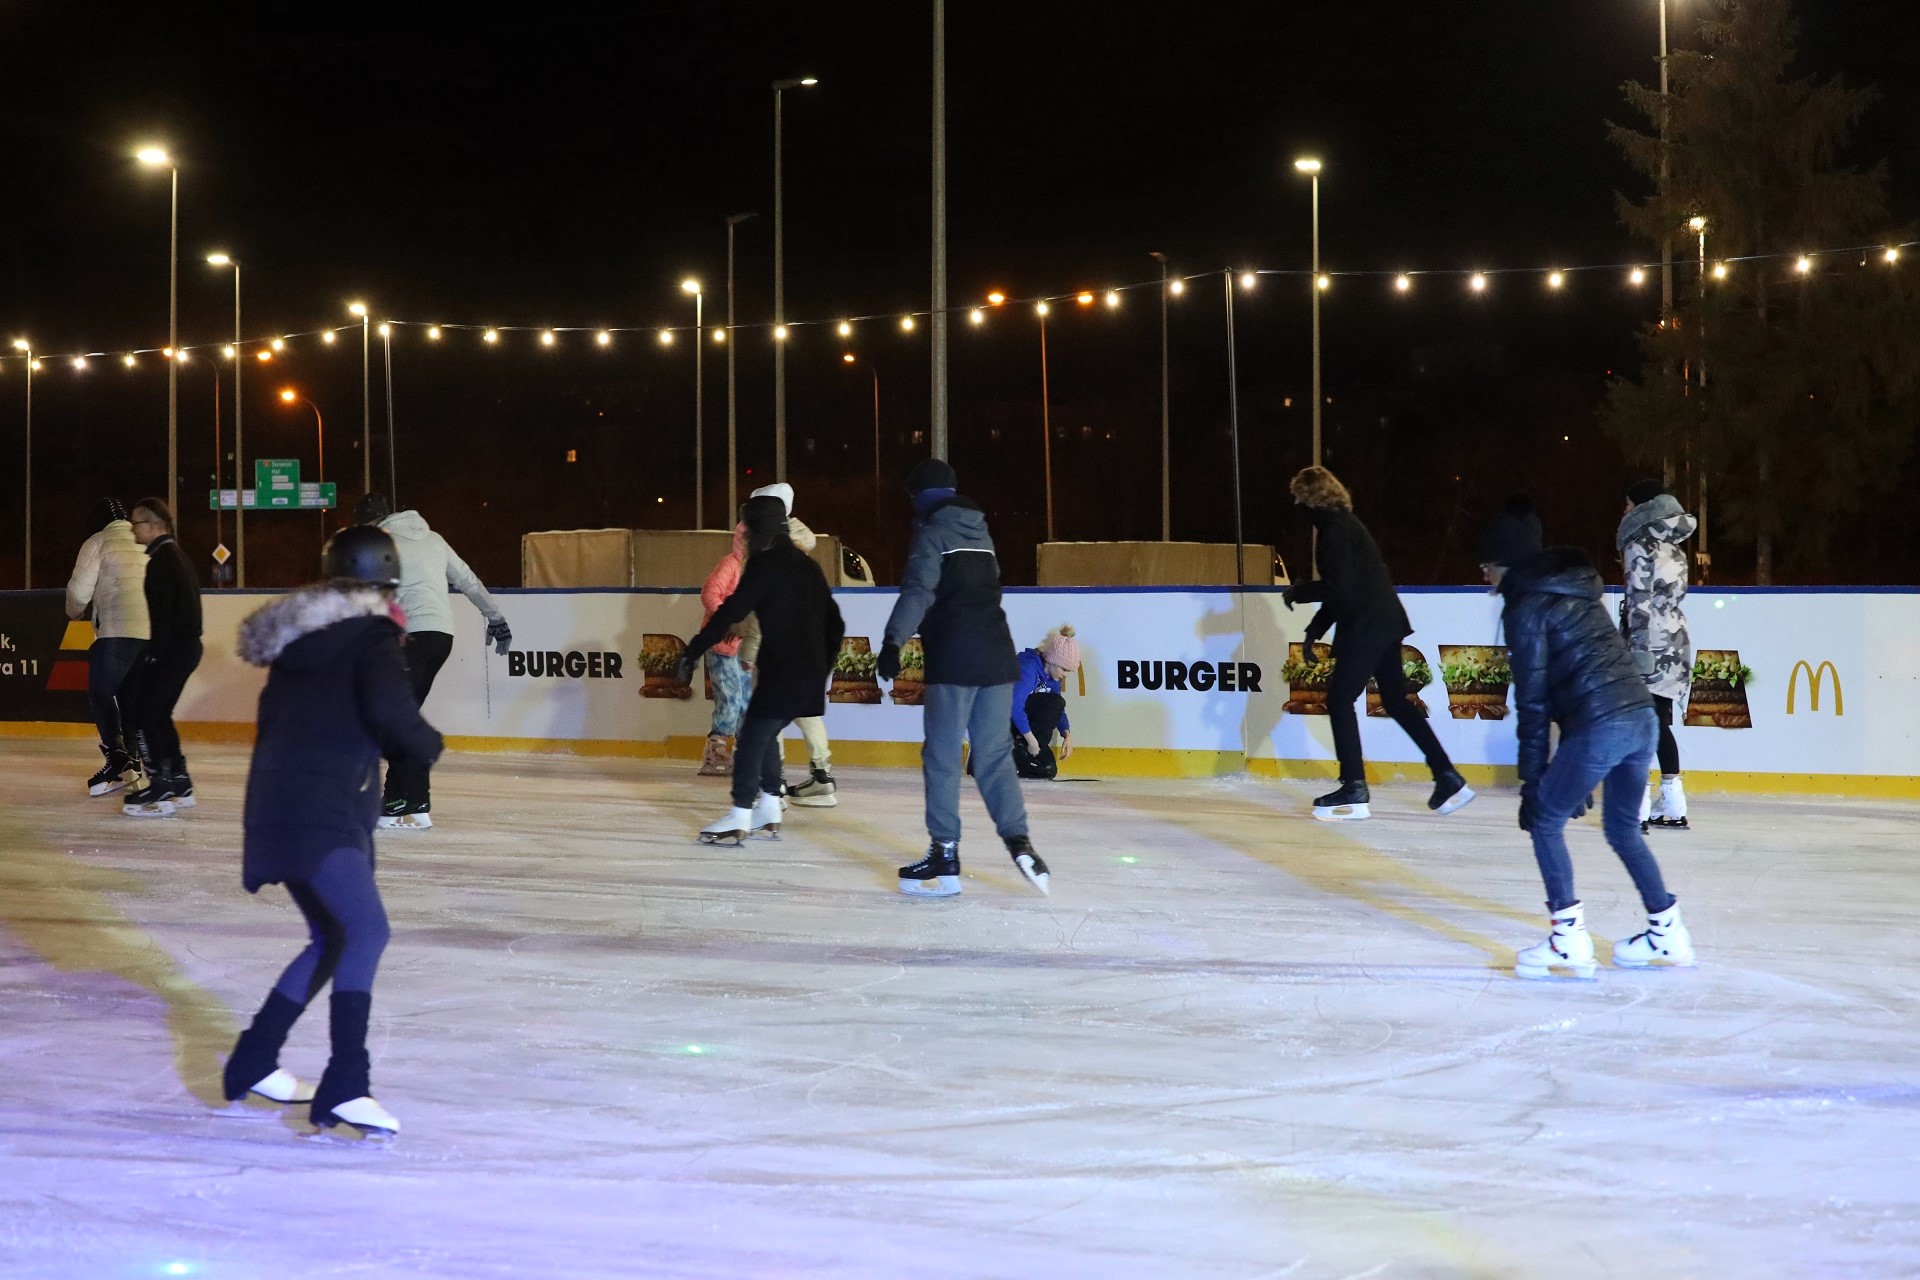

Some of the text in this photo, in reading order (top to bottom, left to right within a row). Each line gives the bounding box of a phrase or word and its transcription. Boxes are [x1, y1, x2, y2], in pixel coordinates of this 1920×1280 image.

[20, 659, 38, 676] 11
[508, 650, 623, 679] BURGER
[1117, 659, 1263, 693] BURGER
